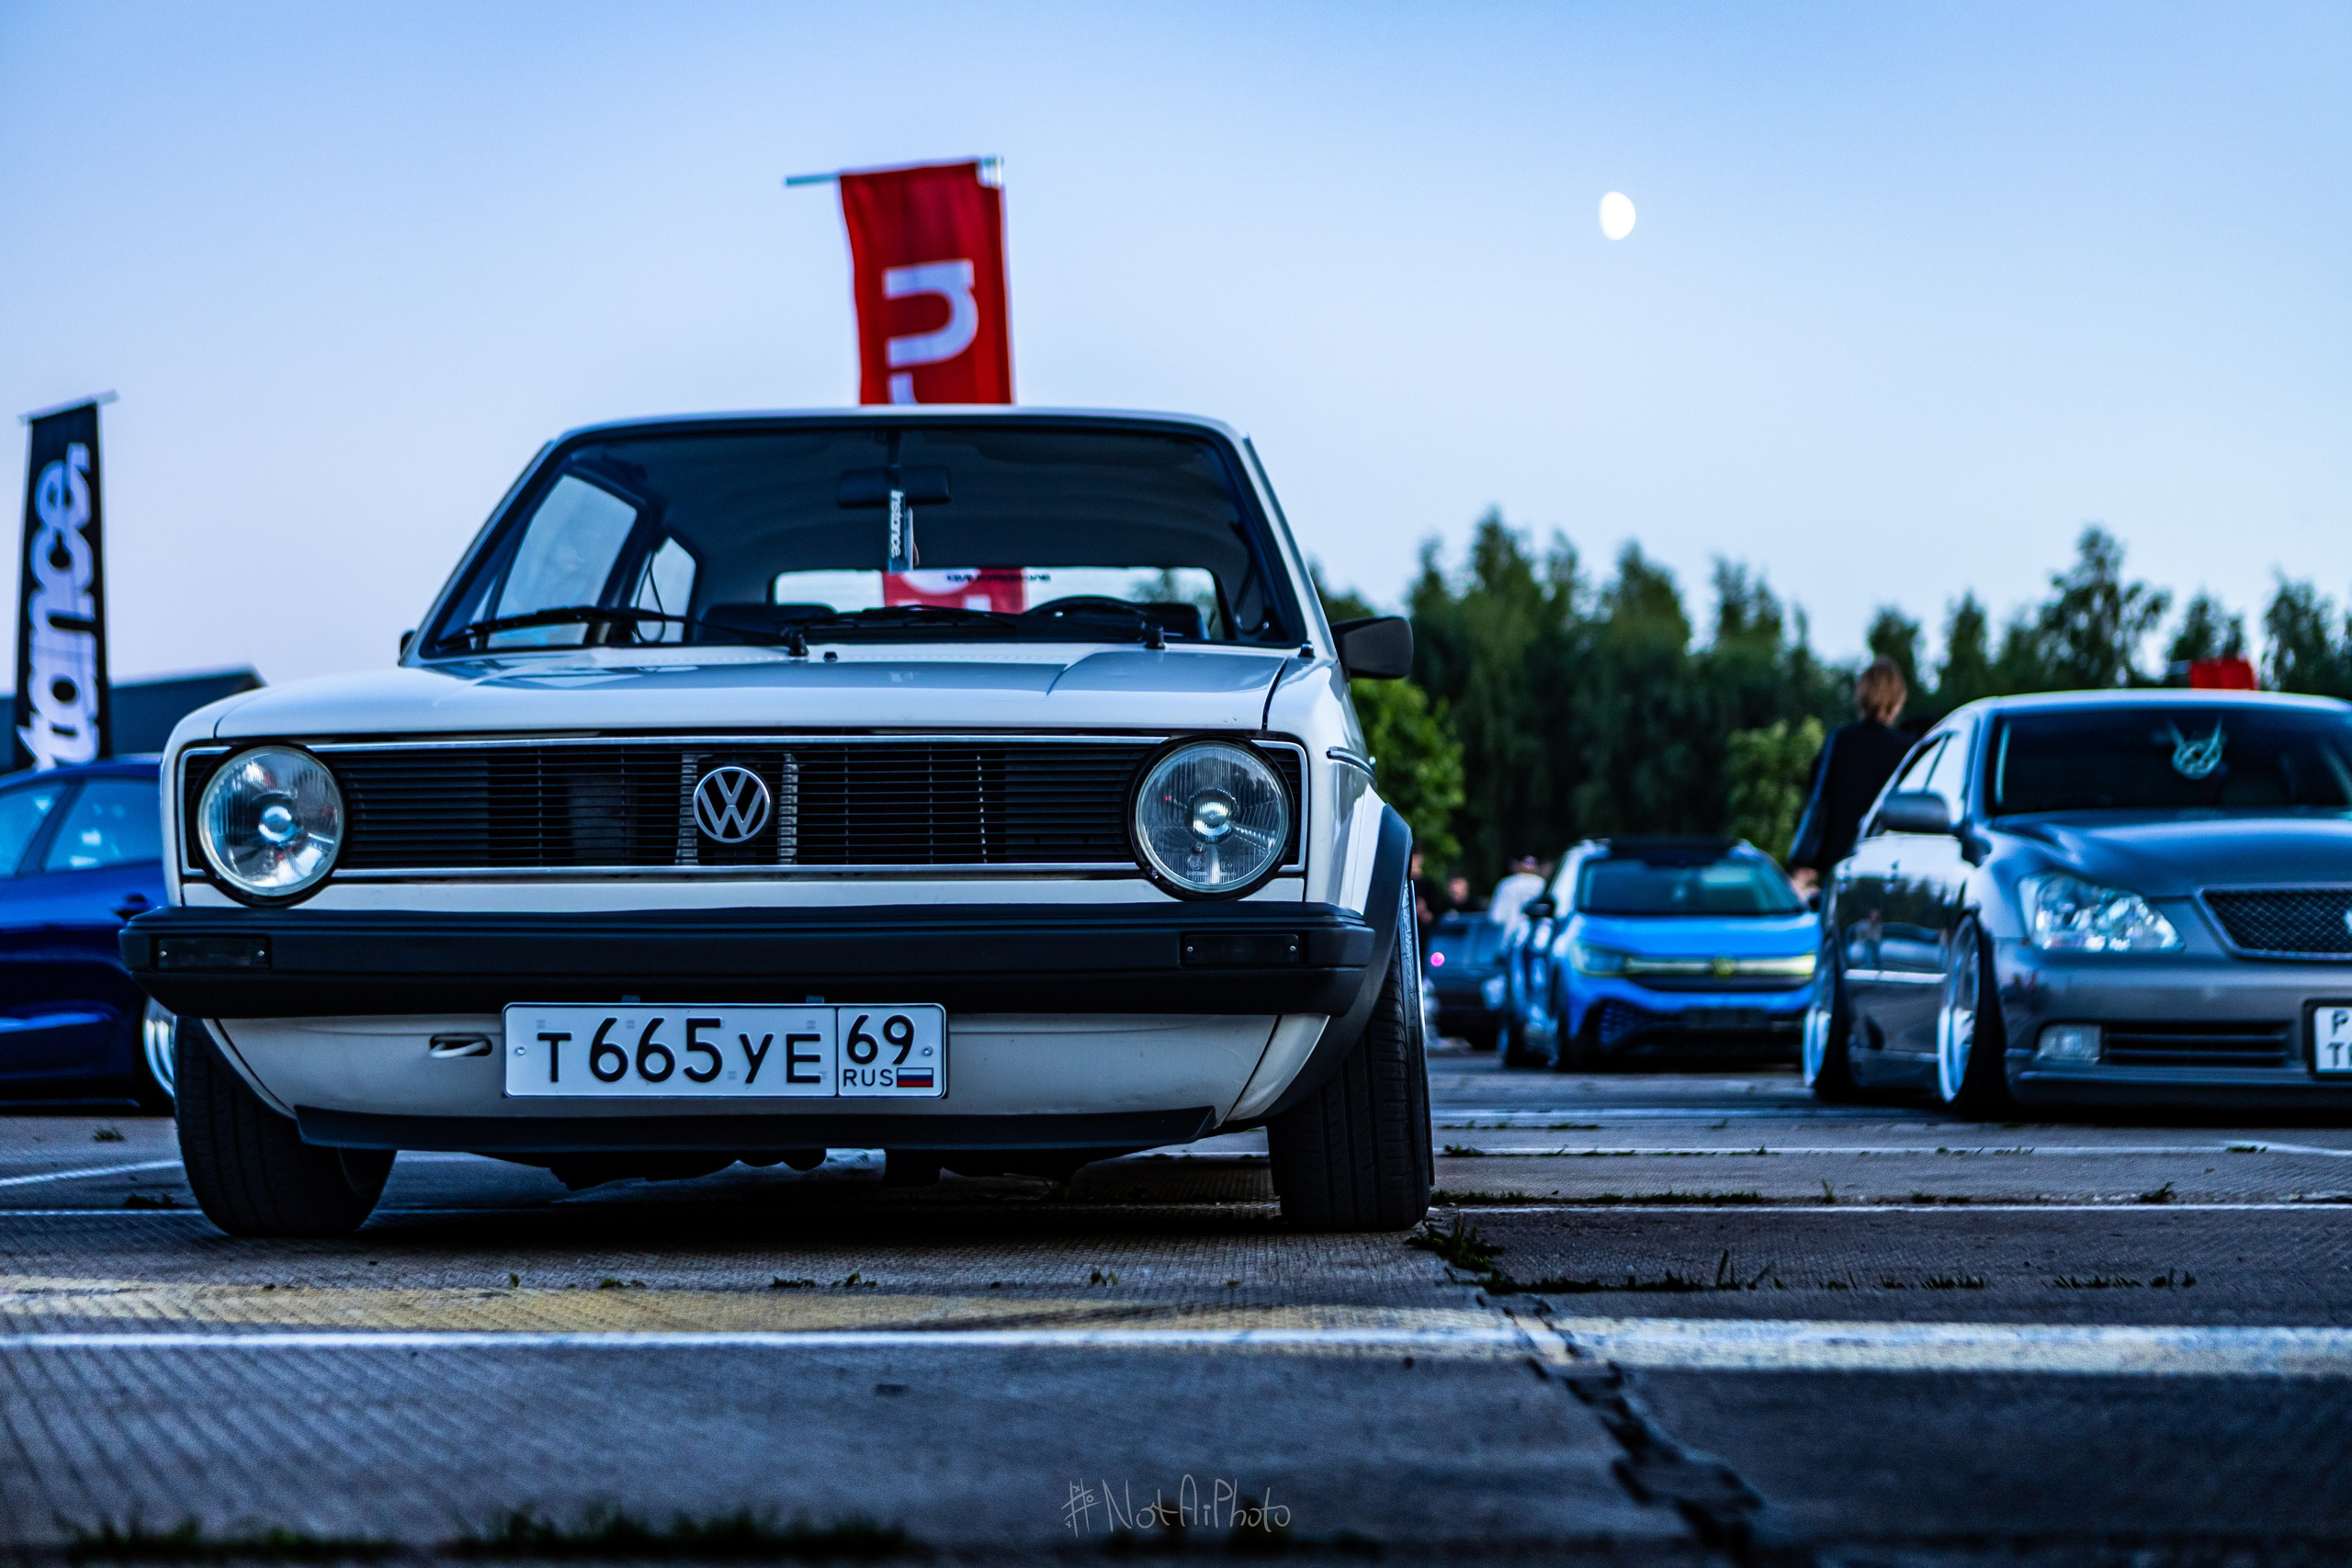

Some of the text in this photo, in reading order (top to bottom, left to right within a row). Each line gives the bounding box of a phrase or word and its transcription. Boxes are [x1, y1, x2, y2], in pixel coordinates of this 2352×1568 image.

[695, 768, 769, 841] VW
[537, 1014, 916, 1084] Т665УЕ 69
[2326, 1041, 2352, 1067] Т
[843, 1068, 894, 1088] RUS
